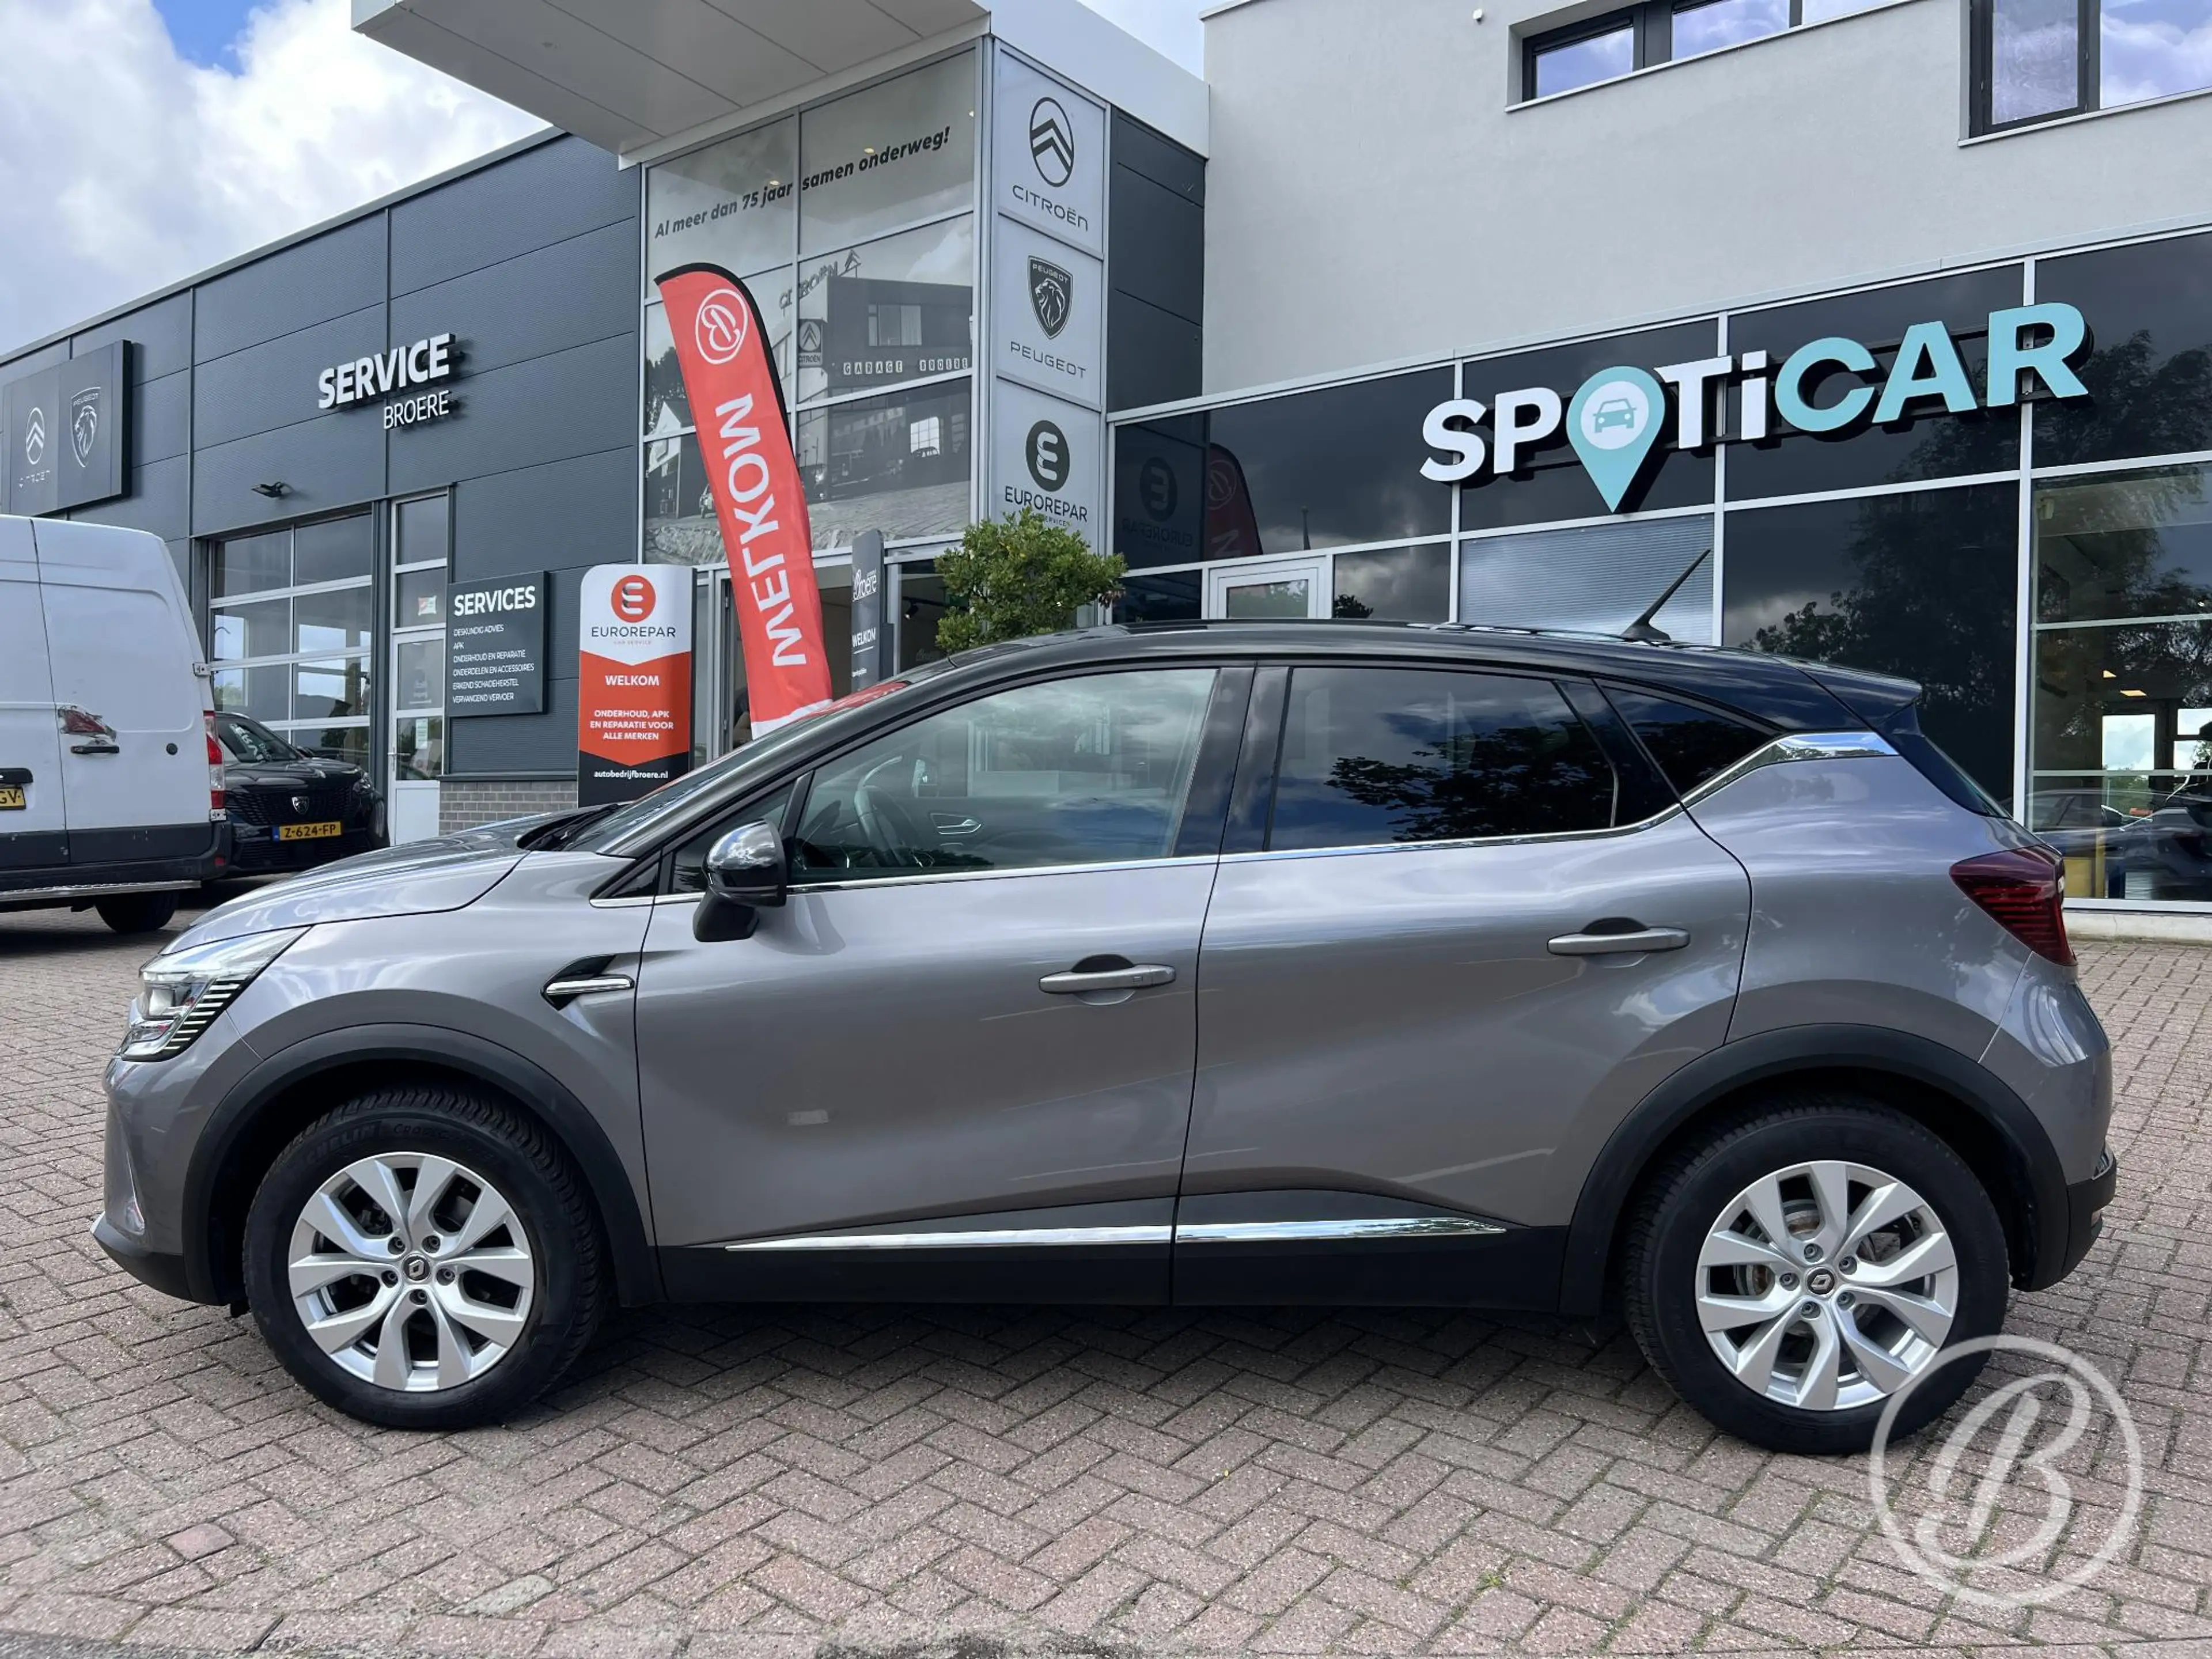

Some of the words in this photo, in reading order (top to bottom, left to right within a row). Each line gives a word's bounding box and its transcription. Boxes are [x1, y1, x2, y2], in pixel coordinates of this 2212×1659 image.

[655, 220, 669, 238] Al
[672, 209, 707, 233] meer
[710, 202, 737, 220] dan
[742, 191, 759, 210] 75
[760, 183, 793, 208] jaar
[802, 162, 854, 191] samen
[859, 126, 950, 171] onderweg!
[1032, 263, 1069, 283] PEUGEOT
[1010, 341, 1086, 378] PEUGEOT
[318, 332, 450, 409] SERVICE
[843, 360, 903, 375] GARAGE
[383, 389, 450, 430] BROERE
[1005, 485, 1088, 522] EUROREPAR
[714, 392, 806, 666] WELKOM
[454, 585, 536, 616] SERVICES
[484, 624, 505, 634] ADVIES
[592, 626, 676, 638] EUROREPAR
[852, 626, 876, 647] WELKOM
[453, 642, 464, 650] APK
[453, 653, 487, 662] ONDERHOUD
[488, 652, 496, 661] EN
[497, 649, 526, 660] REPARATIE
[453, 666, 489, 676] ONDERDELEN
[490, 666, 498, 674] EN
[498, 663, 535, 673] ACCESSOIRES
[453, 681, 474, 690] ERKEND
[475, 678, 519, 688] SCHADEHERSTEL
[605, 675, 660, 686] WELKOM
[453, 694, 488, 703] VERVANGEND
[489, 692, 514, 701] VERVOER
[594, 710, 650, 718] ONDERHOUD,
[648, 721, 674, 729] VOOR
[624, 732, 659, 740] MERKEN
[594, 770, 668, 779] autobedrijfbroere.nl
[285, 824, 336, 838] Z-624-FP
